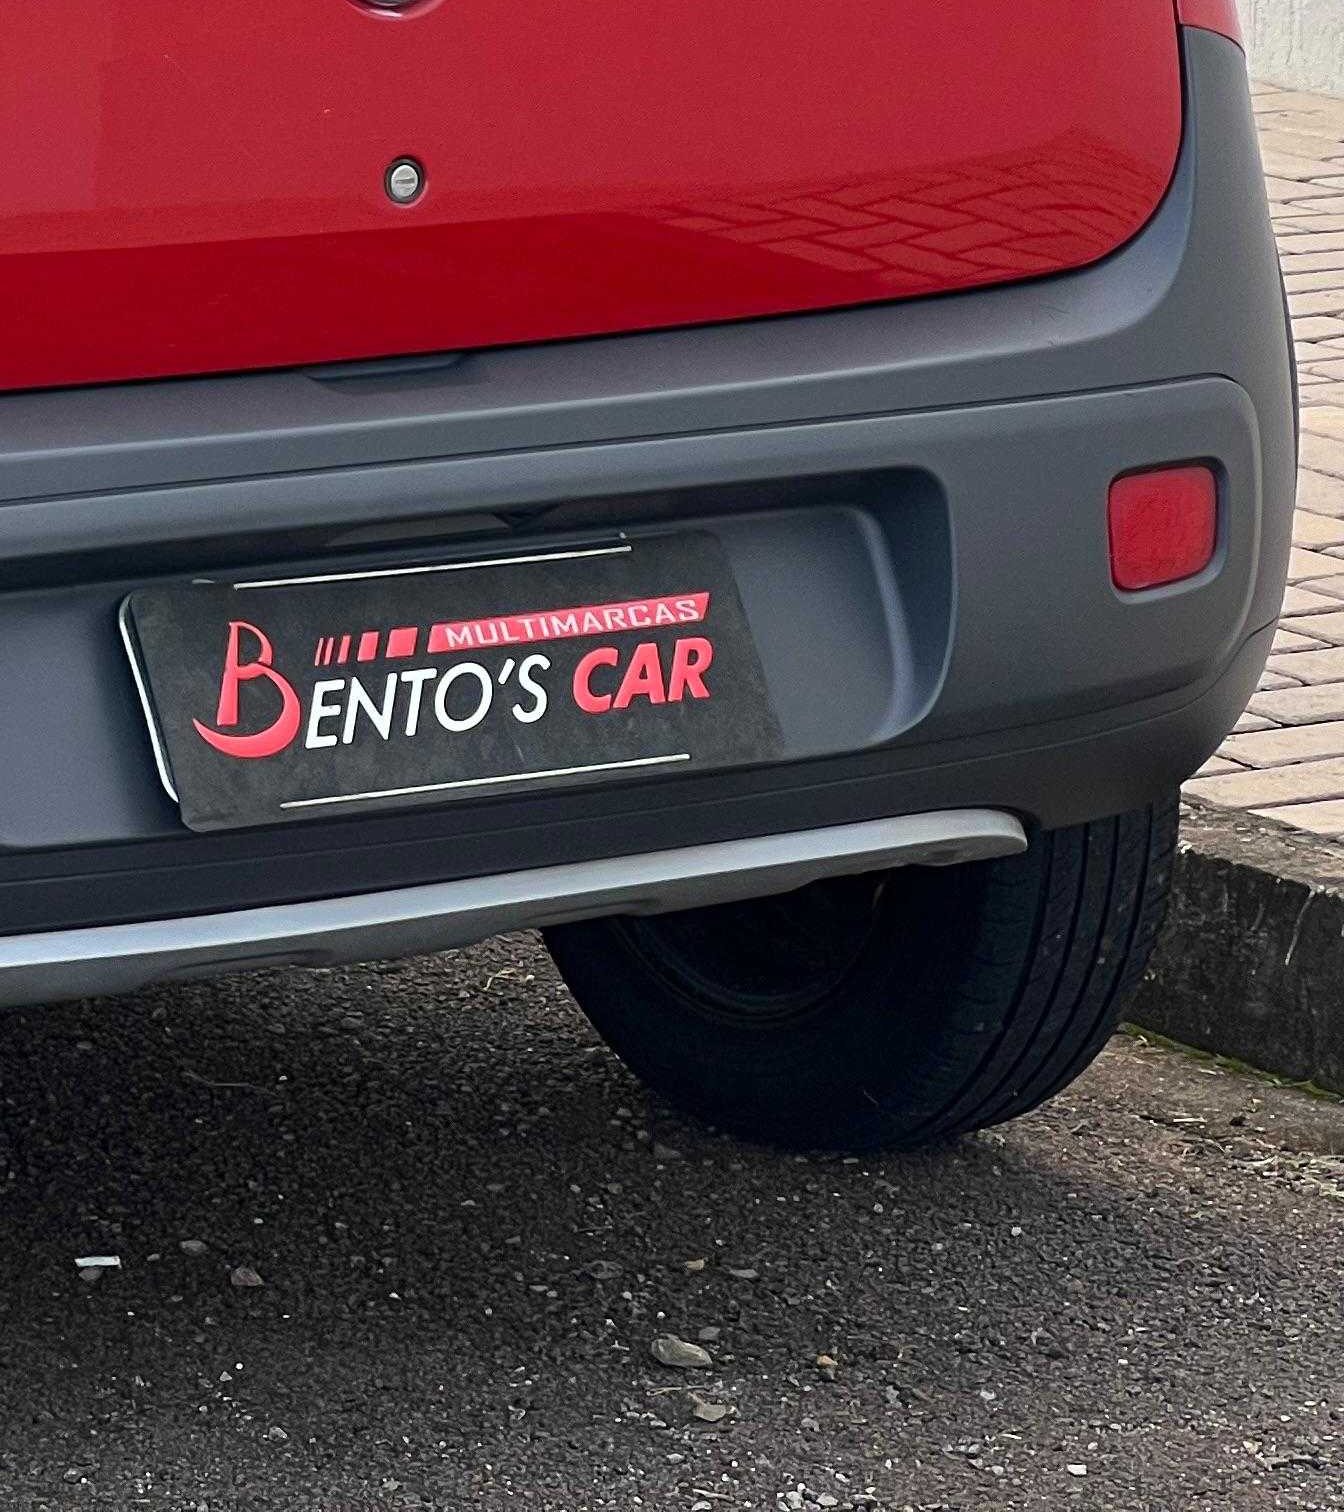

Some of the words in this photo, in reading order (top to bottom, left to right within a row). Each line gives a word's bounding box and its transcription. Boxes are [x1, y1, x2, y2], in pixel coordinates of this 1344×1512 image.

[444, 598, 702, 649] MULTIMARCAS
[193, 621, 551, 758] BENTO'S
[572, 637, 714, 713] CAR
